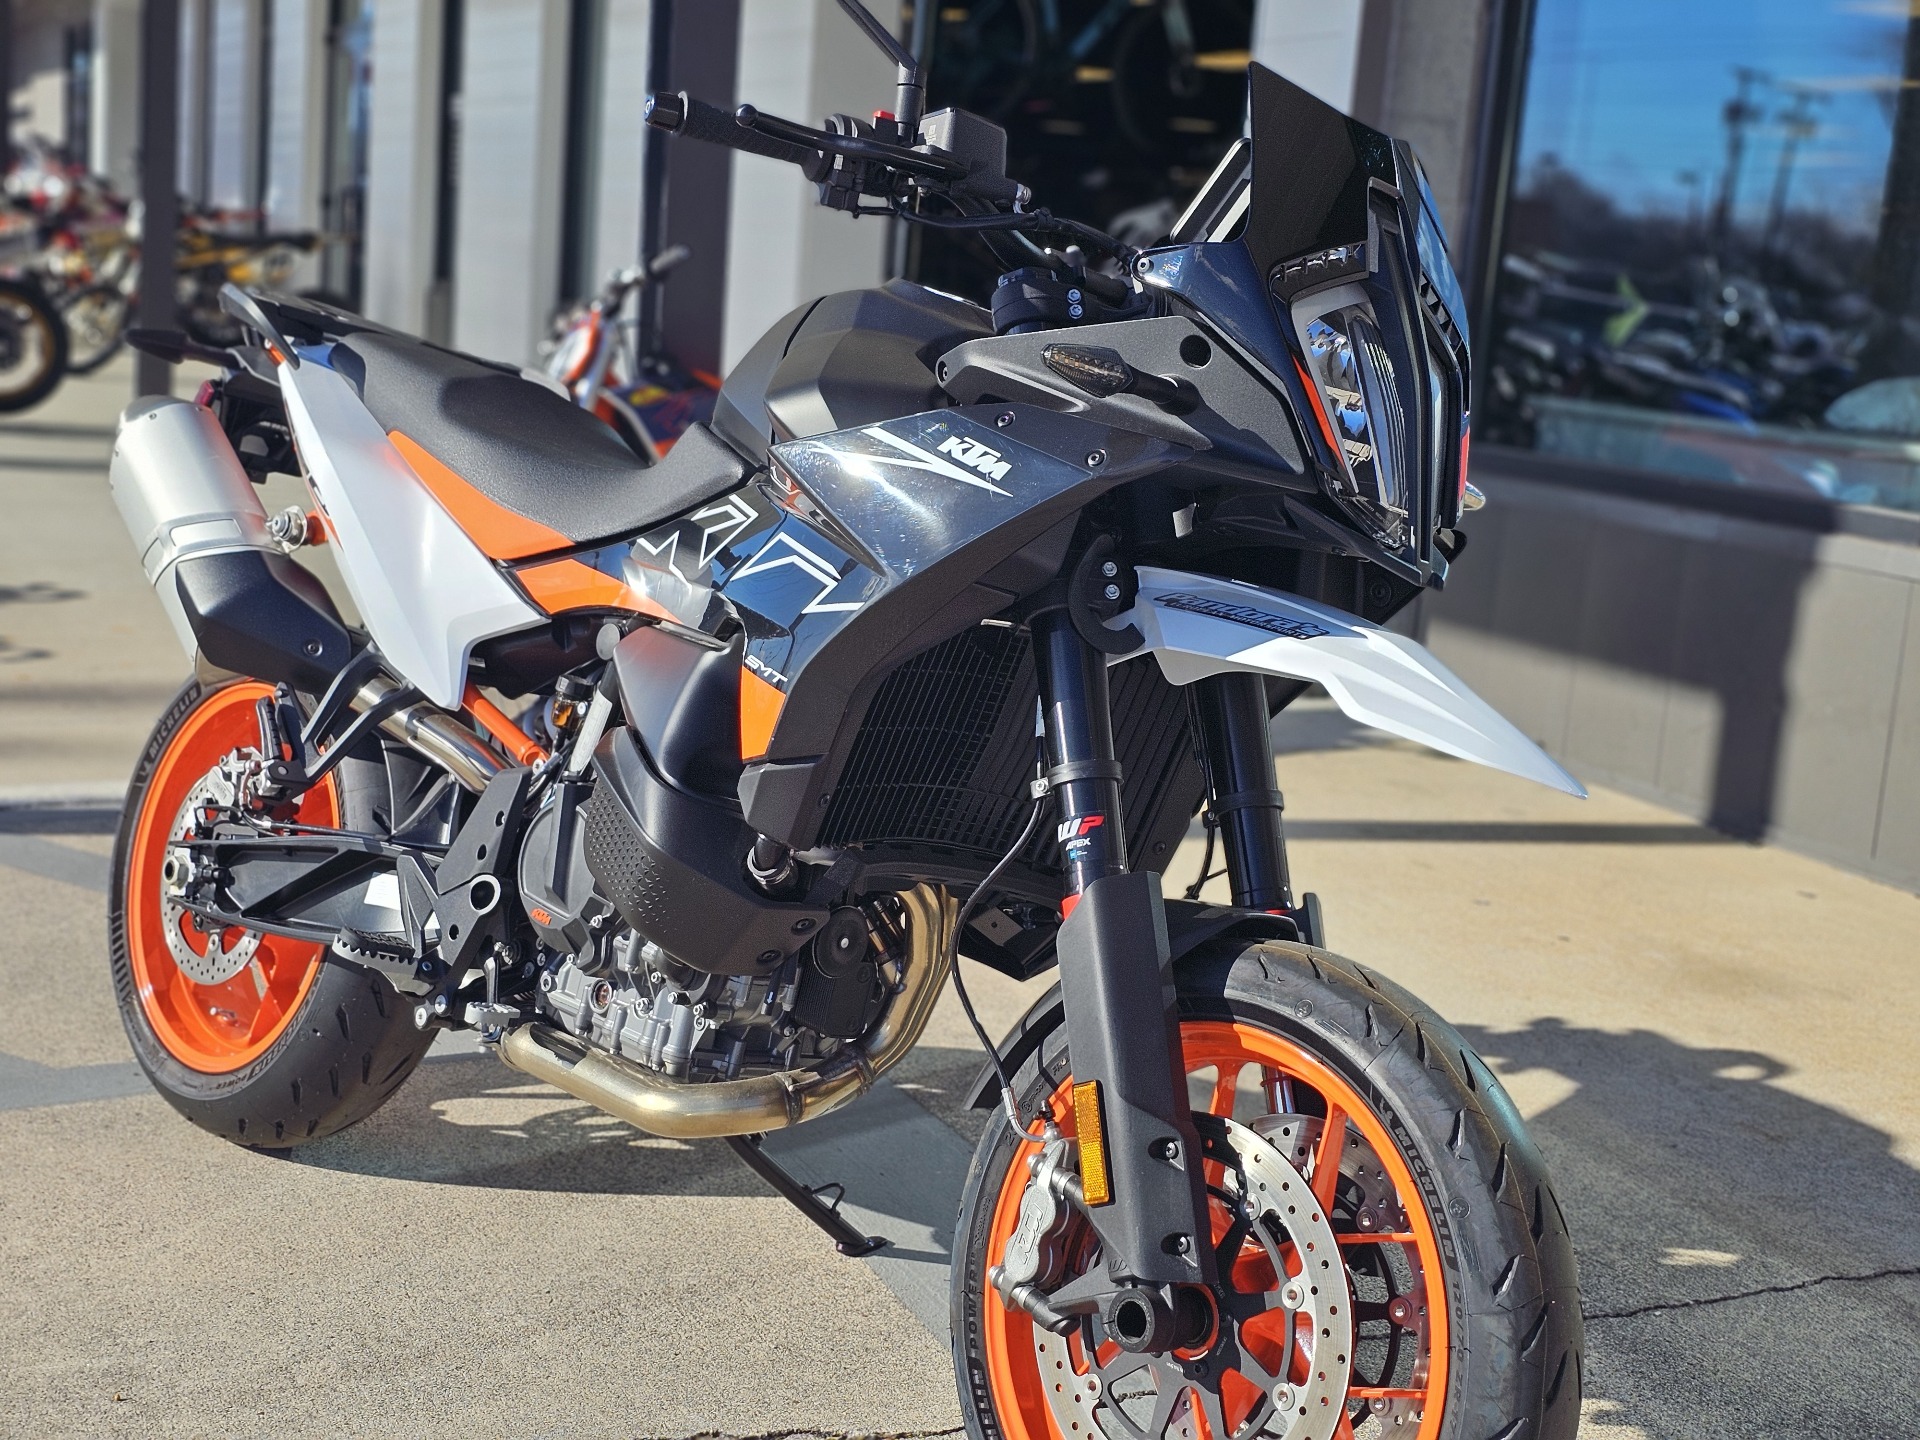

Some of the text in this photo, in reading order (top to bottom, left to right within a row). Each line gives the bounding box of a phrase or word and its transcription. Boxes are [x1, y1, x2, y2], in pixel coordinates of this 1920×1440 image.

[937, 435, 1012, 481] KTM
[744, 654, 788, 683] SMT
[148, 686, 198, 759] MICHELIN
[1057, 815, 1105, 843] WP
[1065, 838, 1091, 851] APEX
[531, 907, 552, 926] KTM
[1394, 1126, 1455, 1258] MICHELIN
[1452, 1280, 1464, 1363] 120/70
[968, 1269, 979, 1350] POWER
